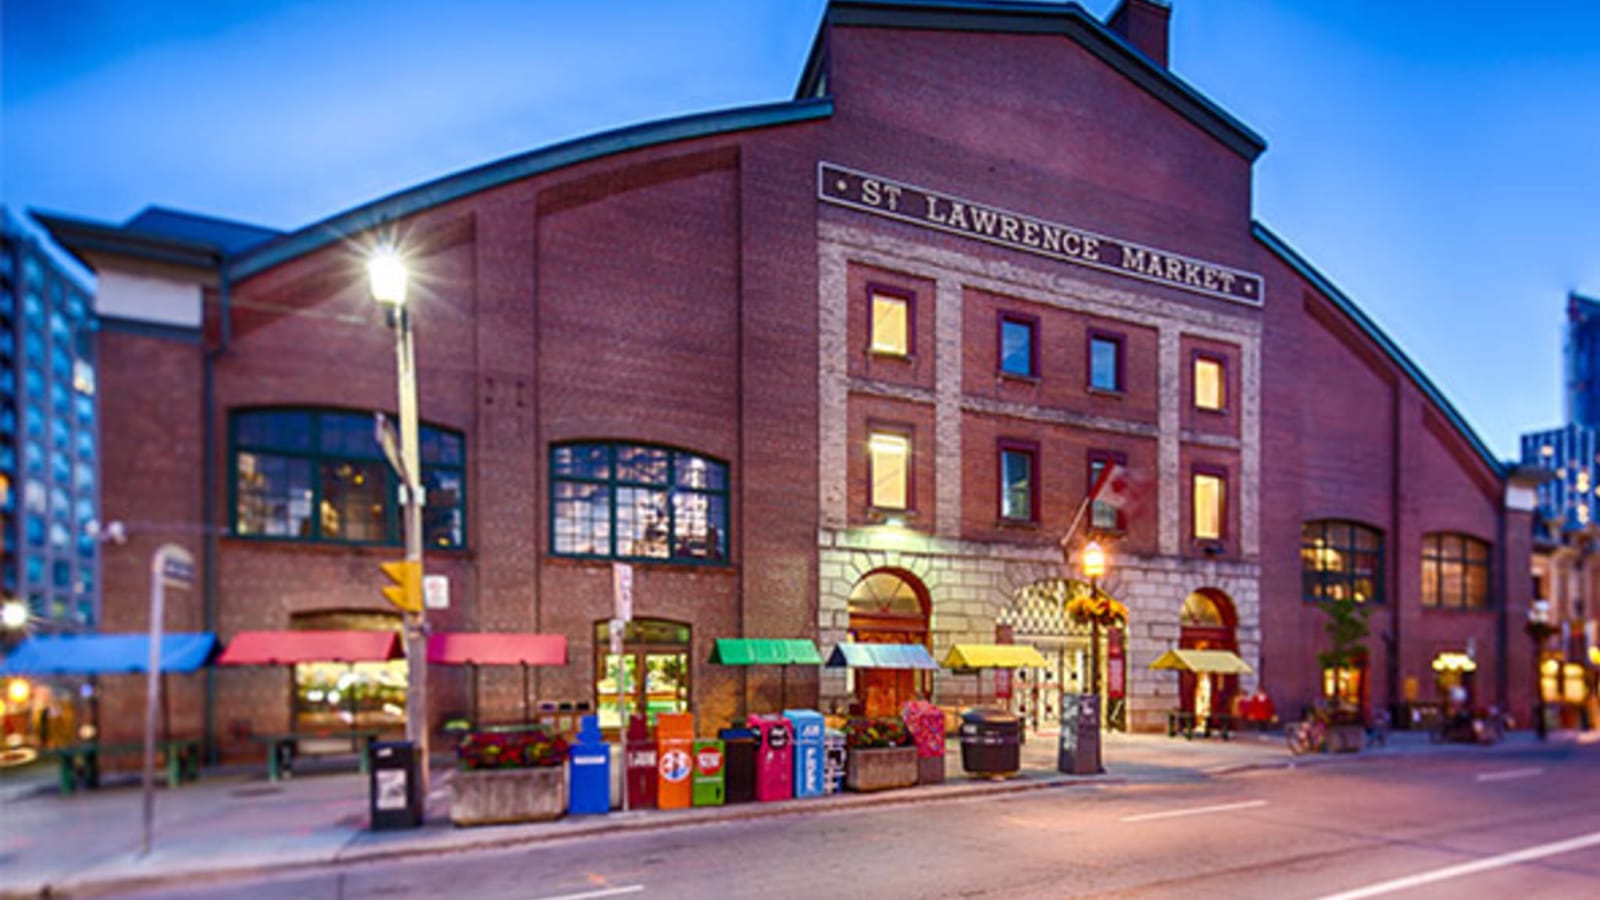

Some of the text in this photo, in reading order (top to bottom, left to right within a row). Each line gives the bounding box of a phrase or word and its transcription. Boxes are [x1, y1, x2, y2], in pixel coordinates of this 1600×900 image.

[861, 179, 1235, 292] ST LAWRENCE MARKET
